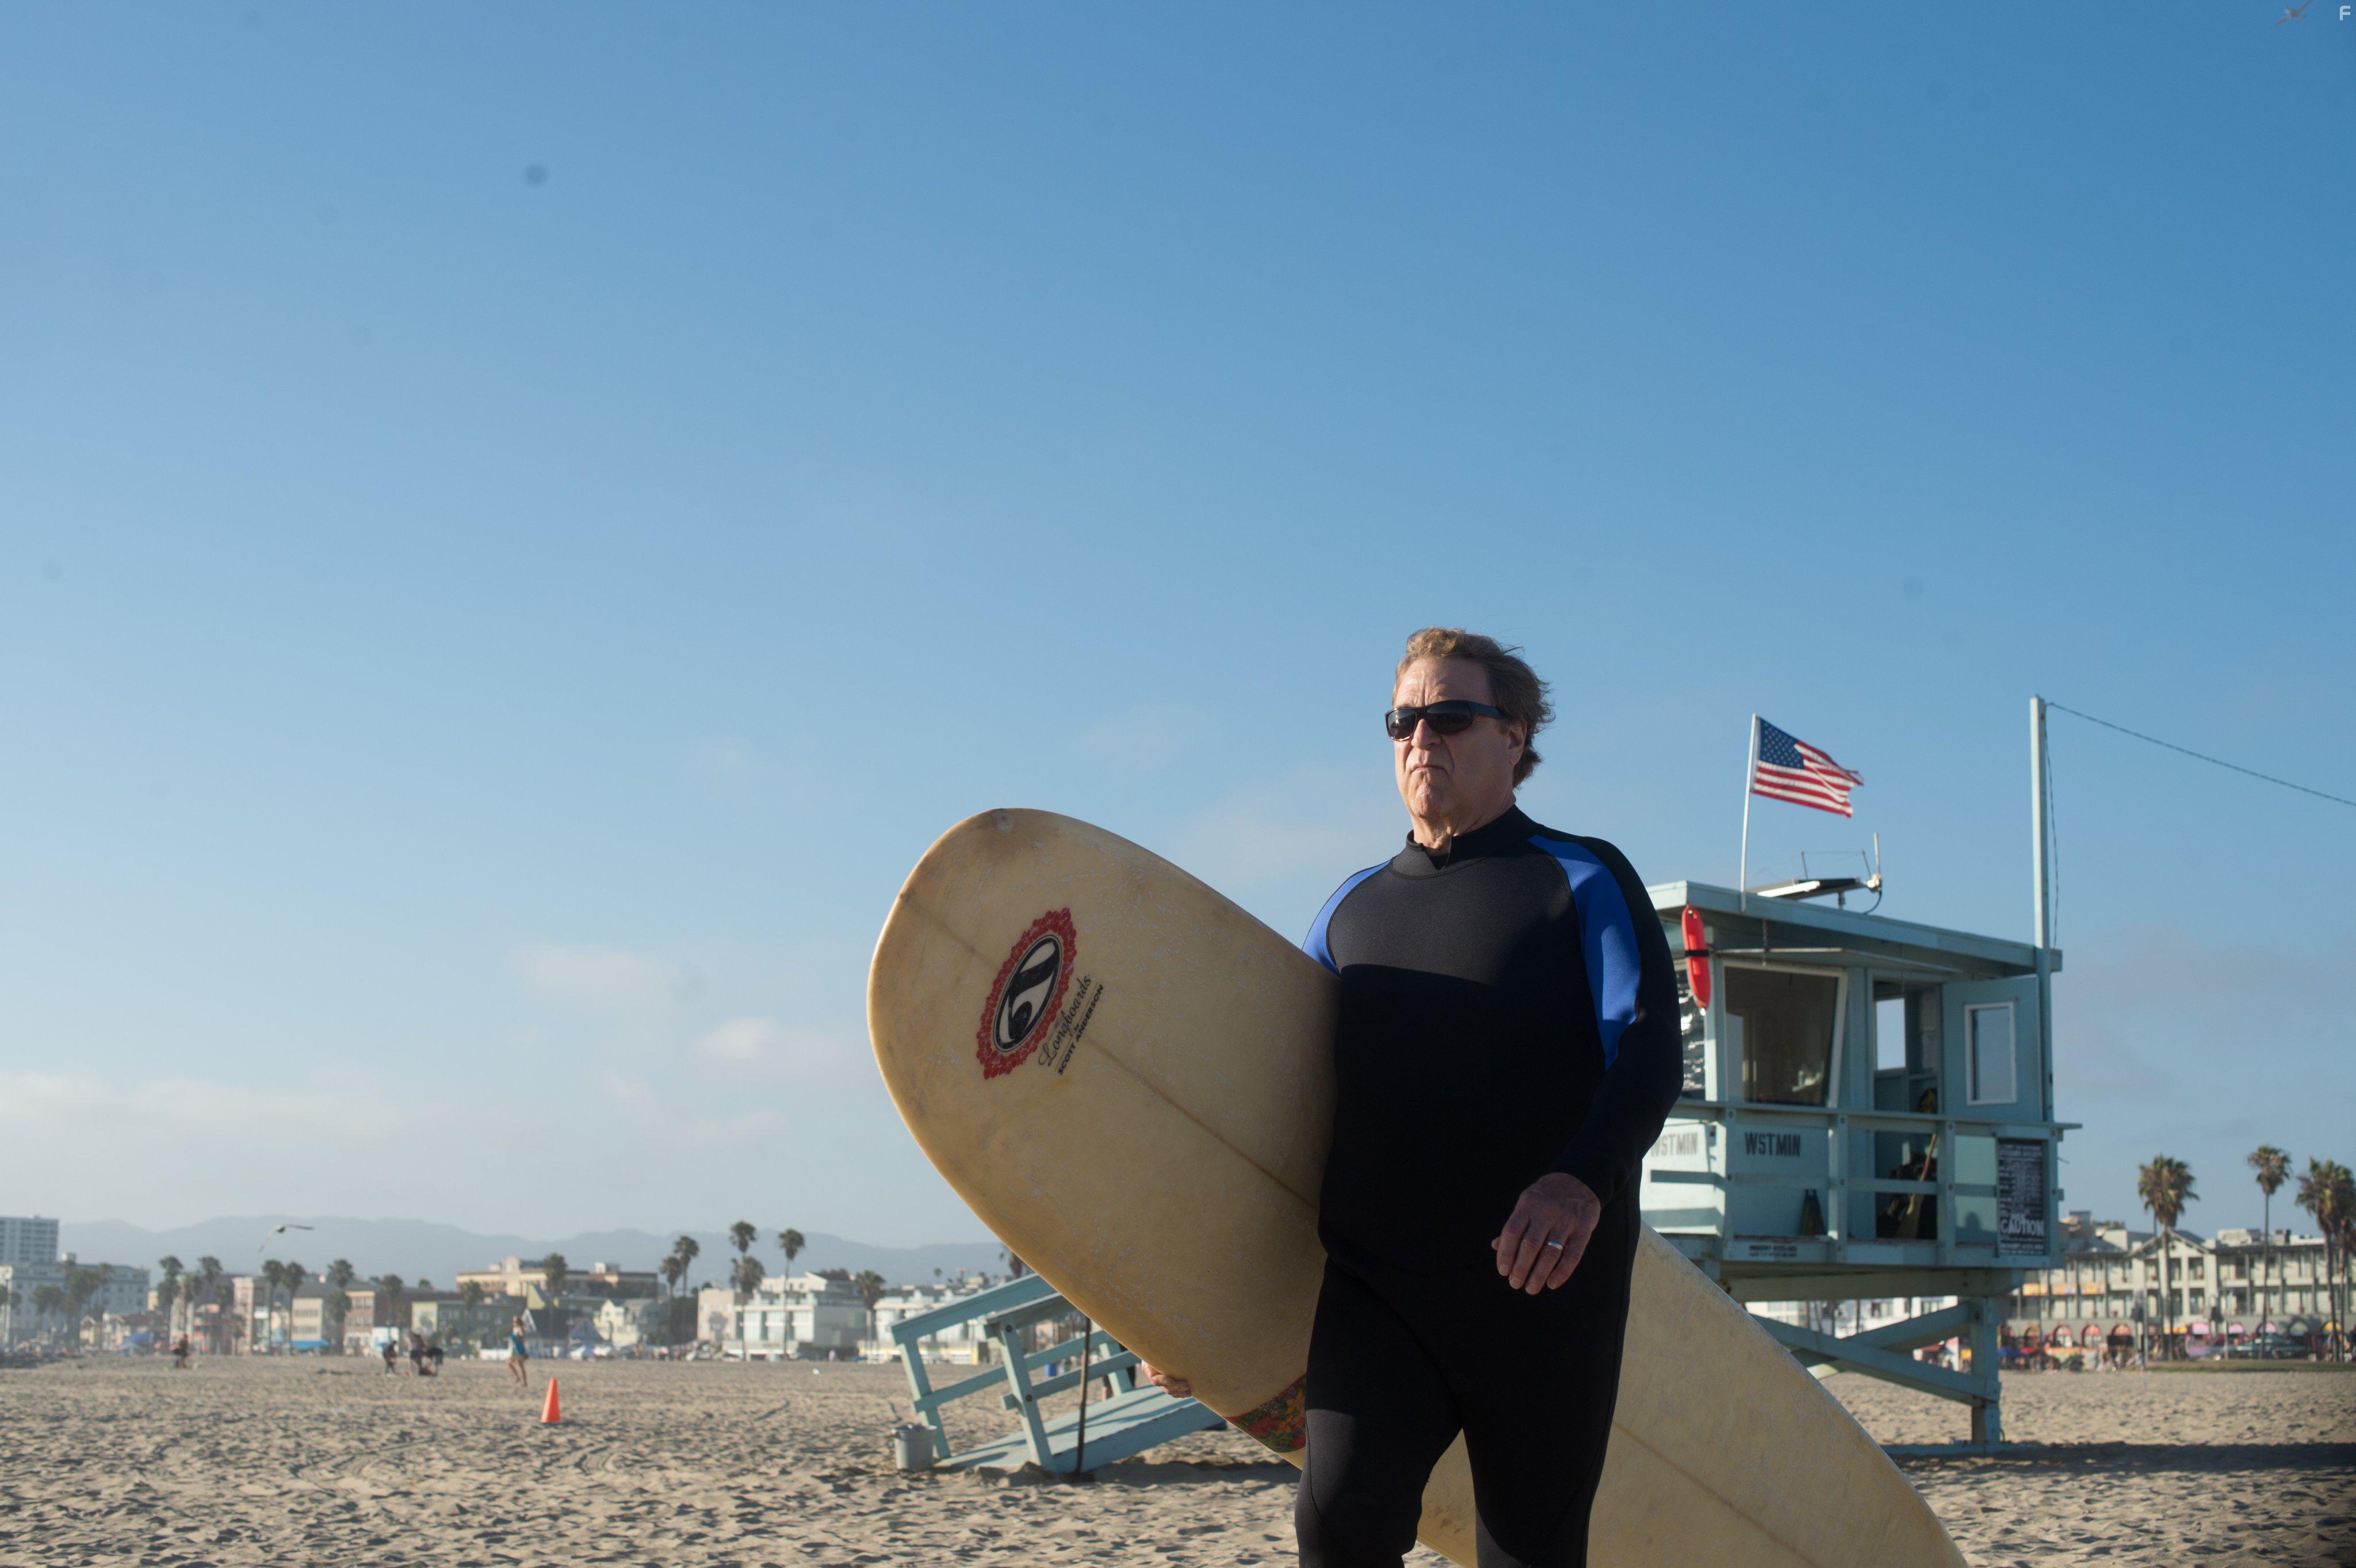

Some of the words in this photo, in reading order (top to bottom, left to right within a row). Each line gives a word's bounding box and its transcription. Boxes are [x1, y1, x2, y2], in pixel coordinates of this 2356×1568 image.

[1038, 976, 1091, 1067] Longboards
[1058, 1043, 1076, 1076] SCOTT
[1076, 984, 1104, 1042] ANDERSON
[1745, 1131, 1802, 1157] WSTMIN
[2000, 1218, 2045, 1236] CAUTION
